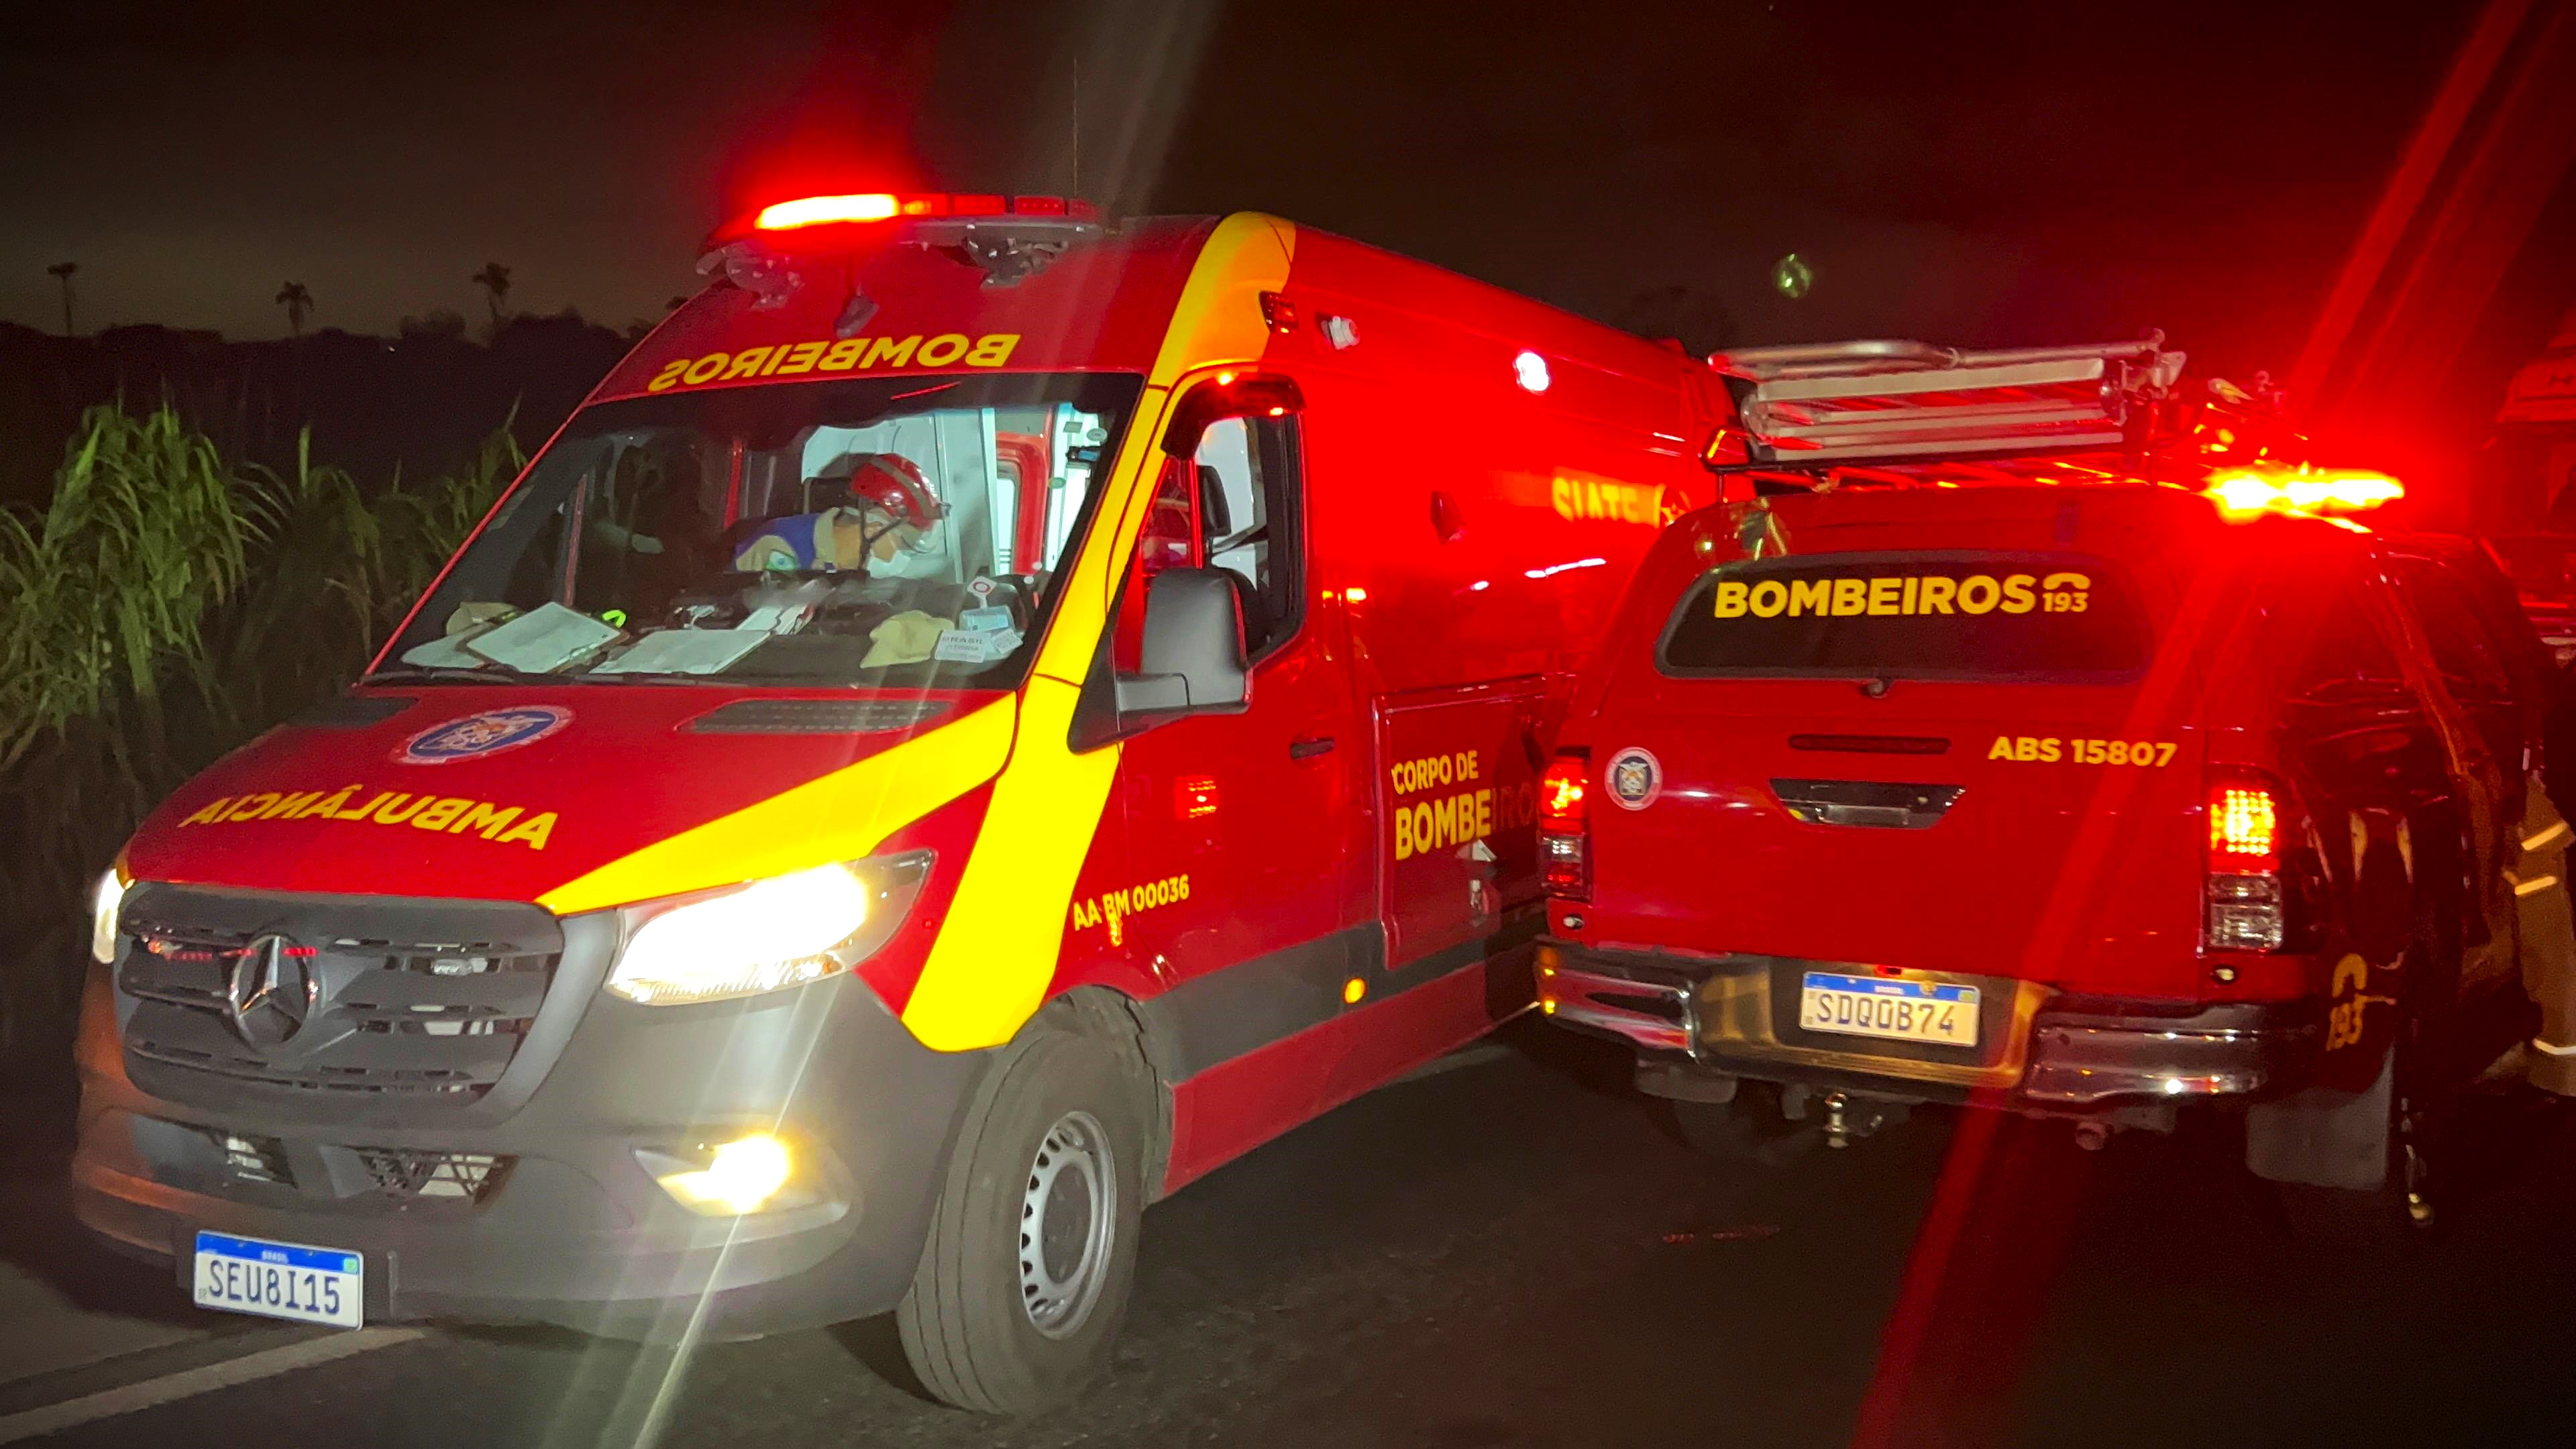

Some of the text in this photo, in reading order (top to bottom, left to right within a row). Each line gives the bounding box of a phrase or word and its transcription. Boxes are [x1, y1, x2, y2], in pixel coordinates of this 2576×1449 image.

[1552, 476, 1640, 524] SIATE
[1714, 574, 2036, 619] BOMBEIROS
[2043, 592, 2088, 613] 193
[1391, 750, 1479, 795] CORPO DE
[1988, 737, 2177, 767] ABS 15807
[1395, 782, 1541, 861] BOMBEIRO
[1073, 873, 1189, 930] AA BM 00036
[209, 1259, 340, 1315] SEU8I15
